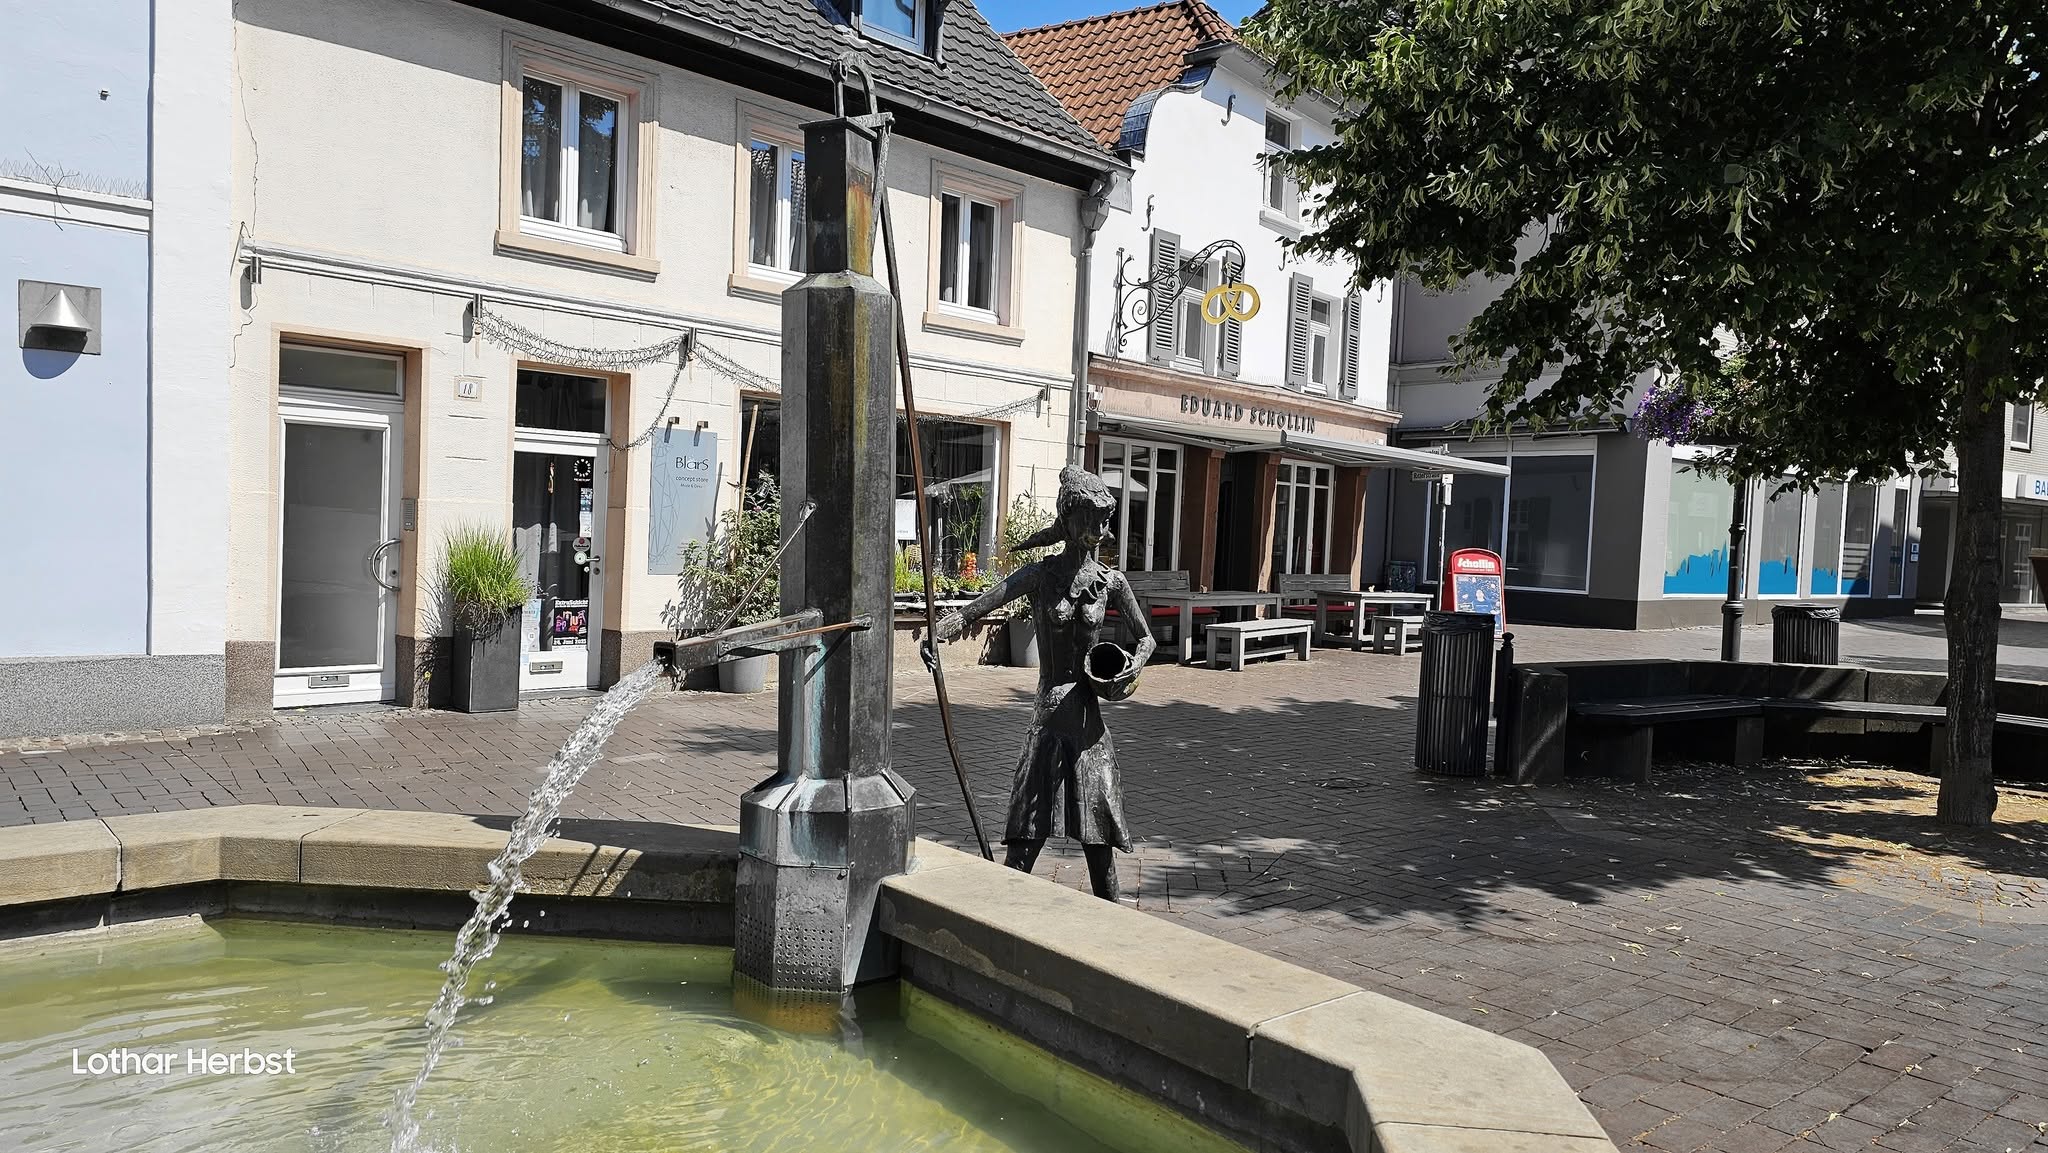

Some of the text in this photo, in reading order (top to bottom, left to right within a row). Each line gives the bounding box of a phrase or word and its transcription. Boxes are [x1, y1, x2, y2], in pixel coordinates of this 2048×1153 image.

[1180, 394, 1316, 434] EDUARD SCHOLLIN
[2034, 480, 2048, 496] BA
[1457, 557, 1495, 569] Schollin
